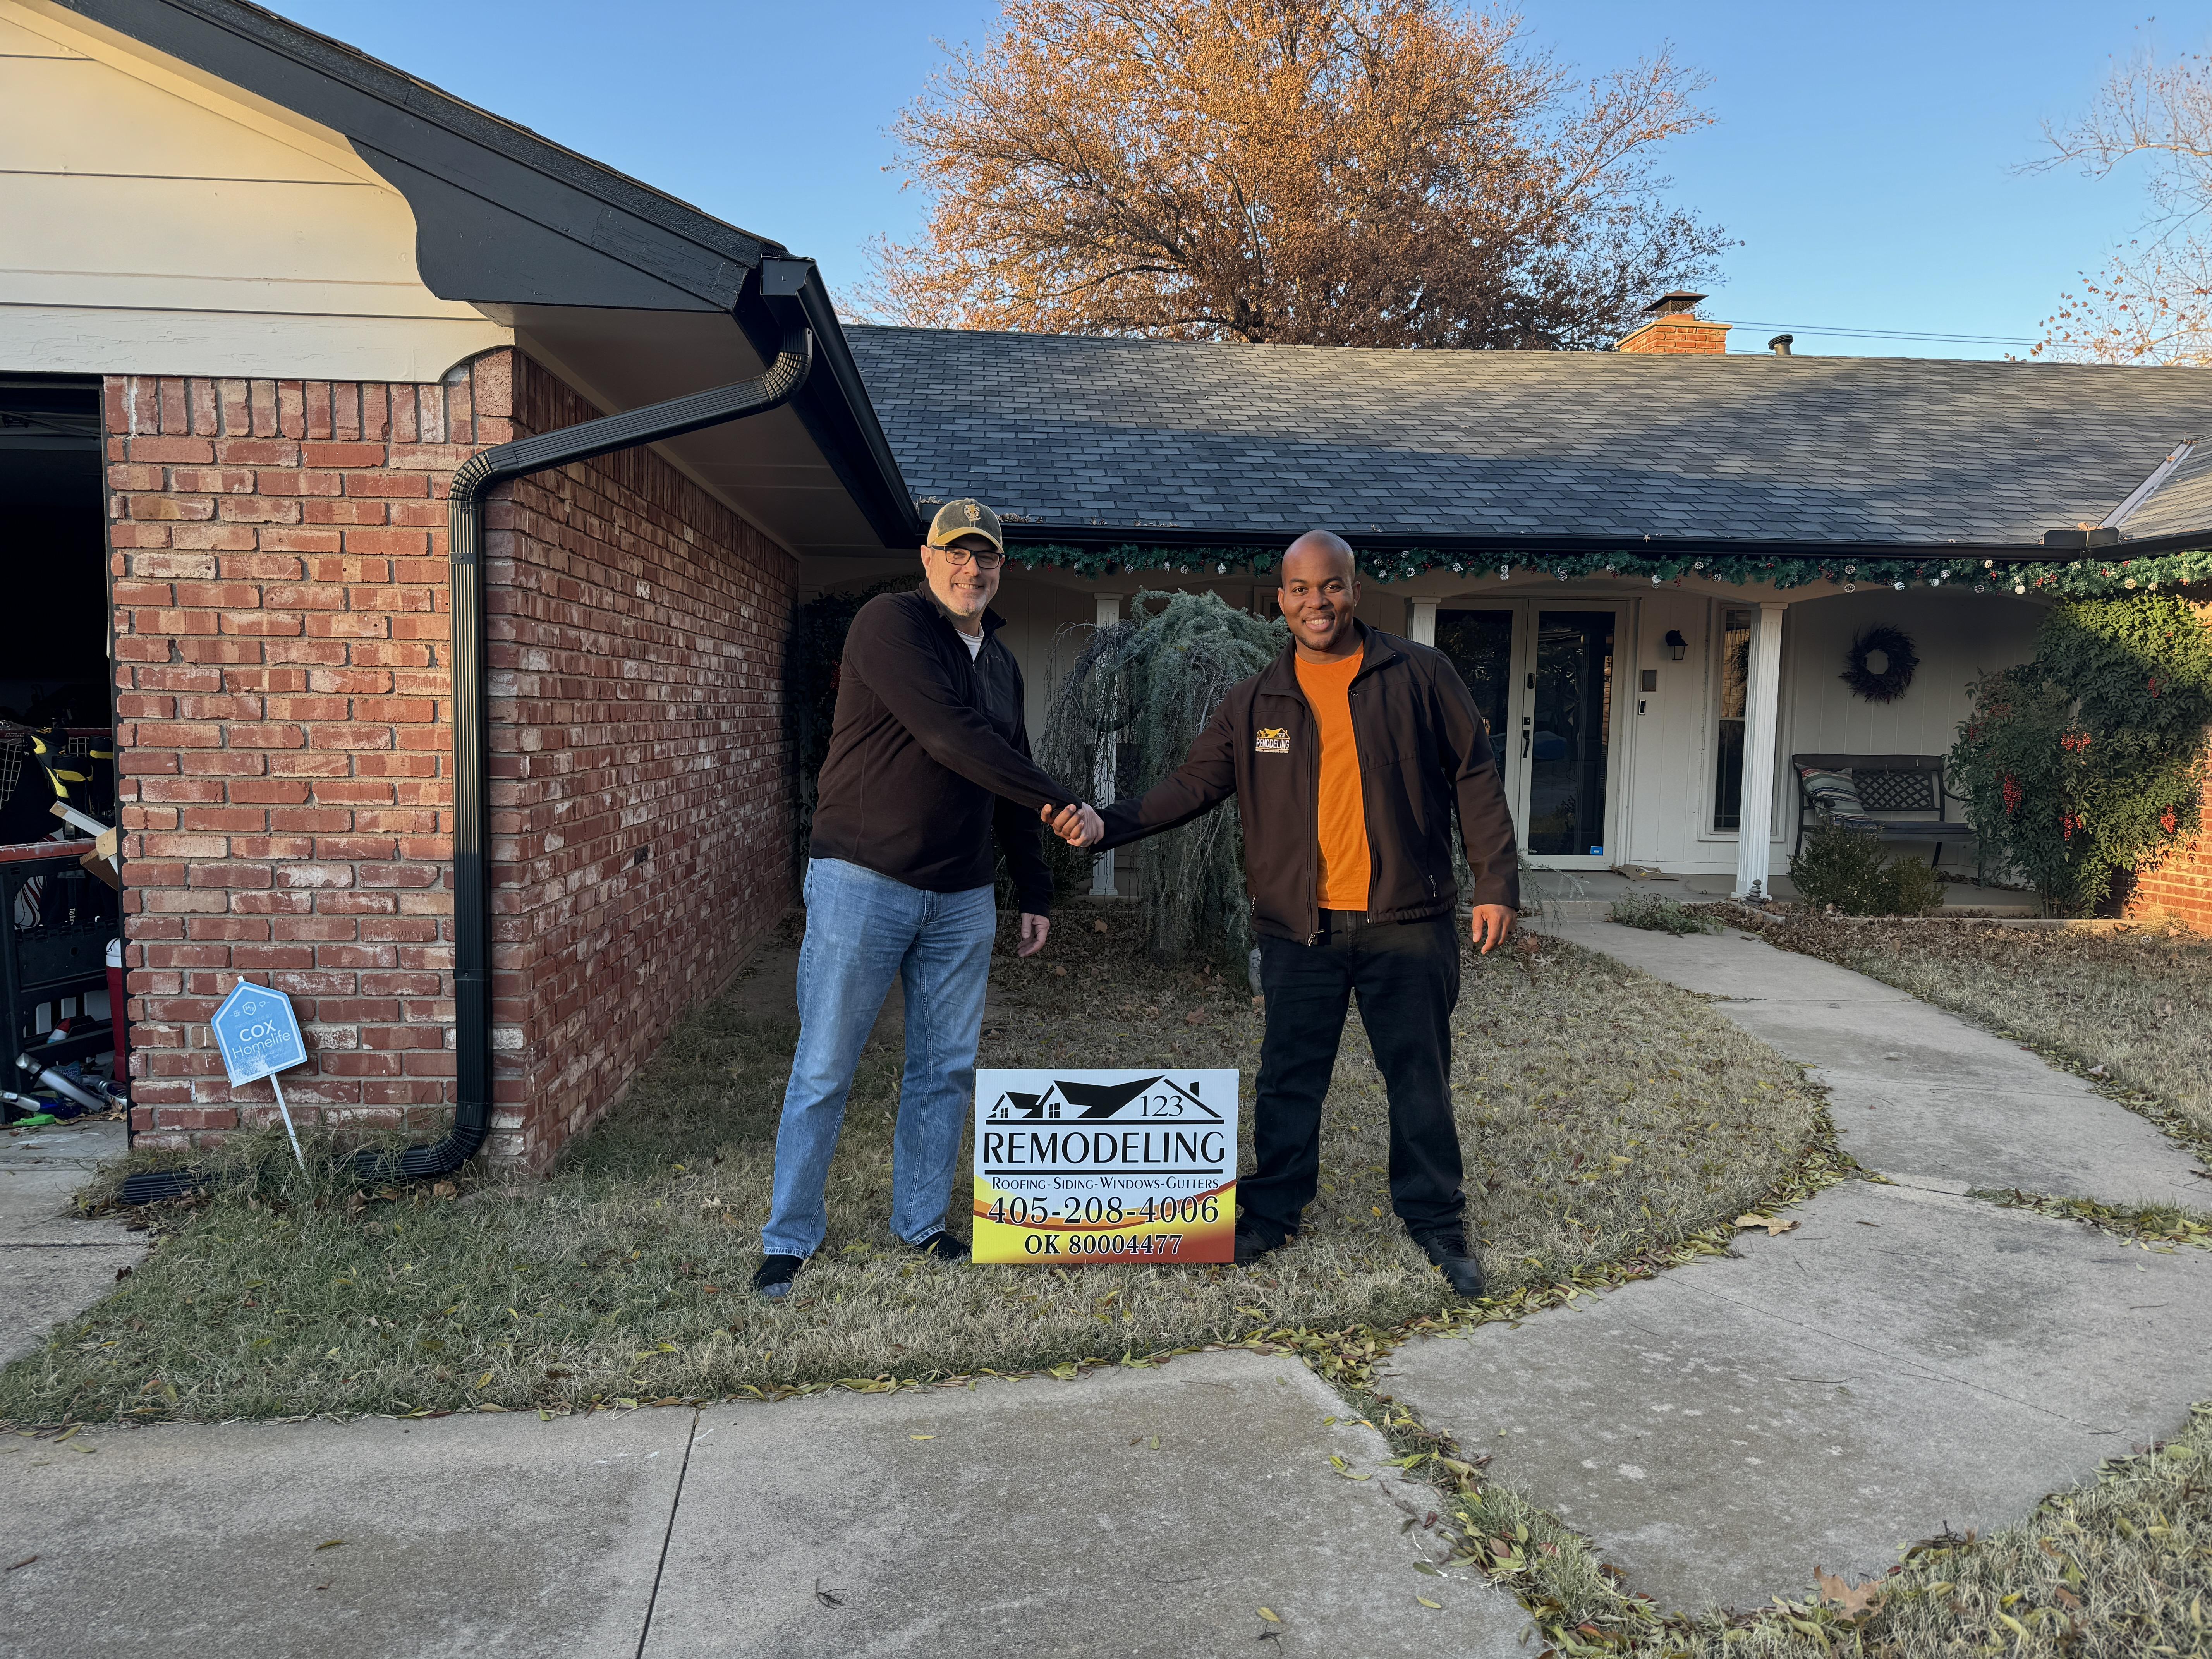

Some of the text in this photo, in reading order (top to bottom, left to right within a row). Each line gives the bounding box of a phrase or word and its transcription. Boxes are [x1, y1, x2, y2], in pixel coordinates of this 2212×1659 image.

[1256, 738, 1290, 749] REMODELING
[239, 1019, 276, 1042] COX
[232, 1030, 290, 1059] Homelife
[1140, 1095, 1183, 1117] 123
[984, 1131, 1224, 1164] REMODELING
[988, 1196, 1219, 1224] 405-208-4006
[1025, 1235, 1182, 1254] OK 80004477
